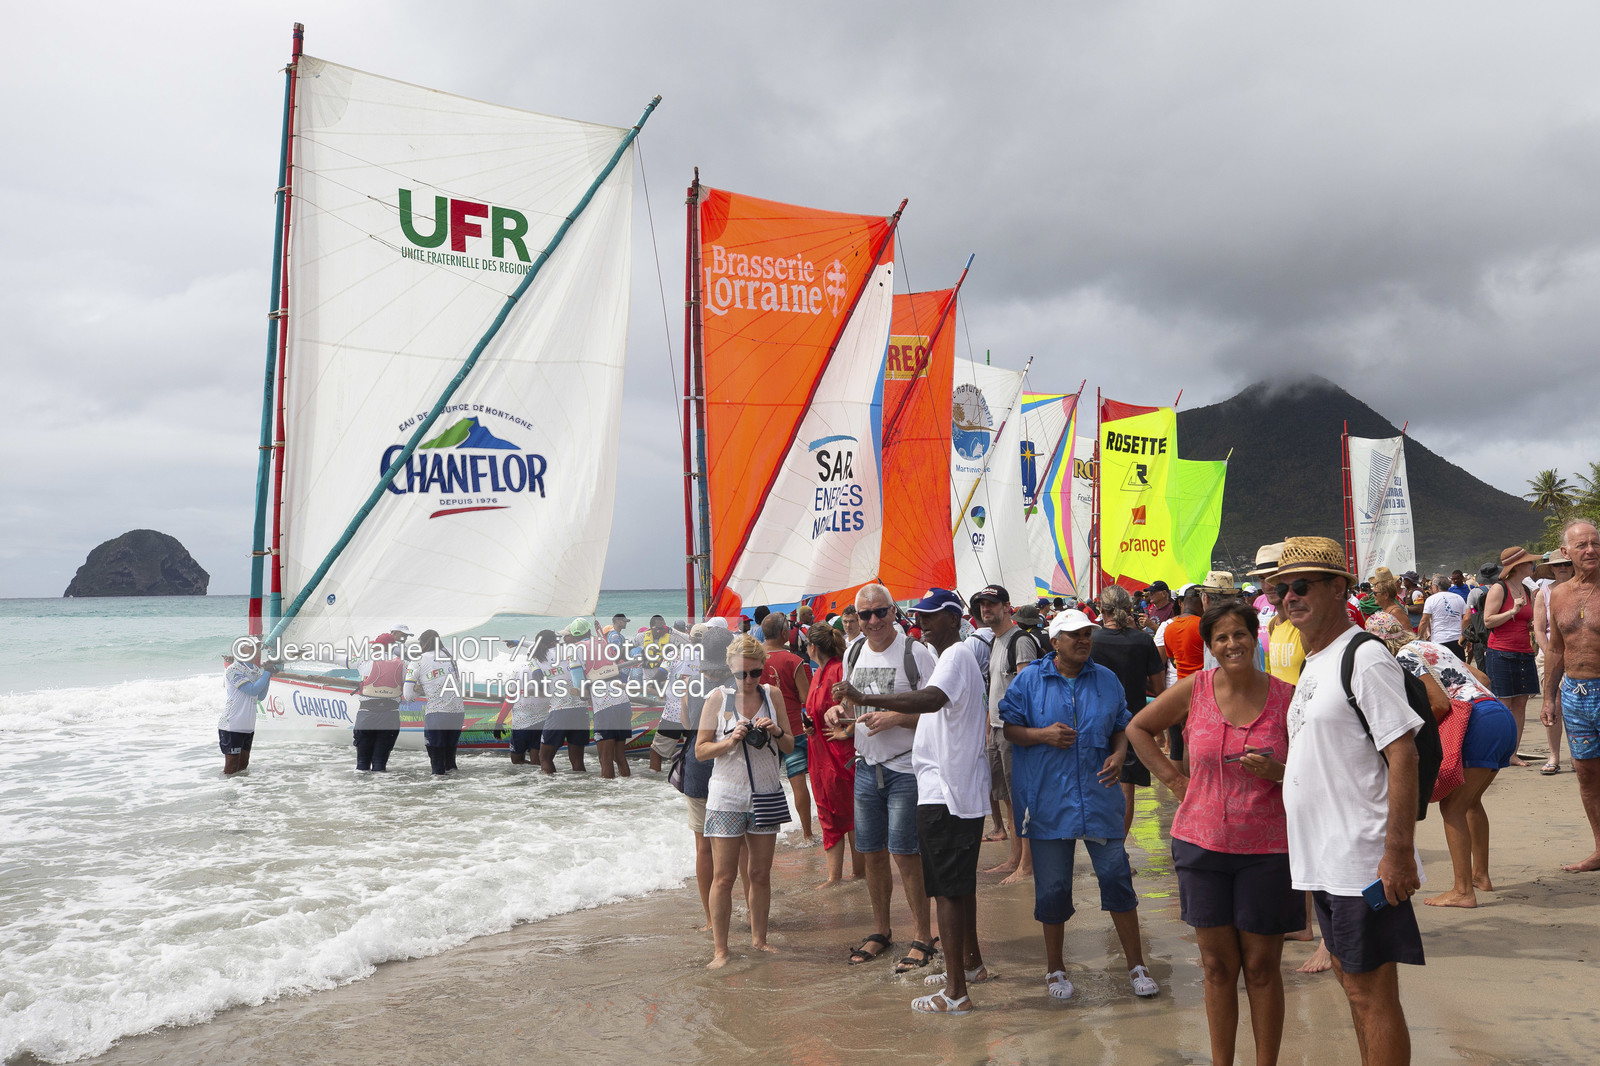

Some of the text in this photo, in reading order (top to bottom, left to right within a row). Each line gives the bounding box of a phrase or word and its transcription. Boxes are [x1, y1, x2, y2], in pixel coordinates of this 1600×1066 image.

[398, 188, 532, 263] UFR
[401, 246, 425, 262] UNITE
[427, 251, 480, 270] FRATERNELLE
[482, 259, 497, 272] DES
[711, 245, 815, 283] Brasserie
[704, 266, 823, 316] Lorraine
[398, 417, 415, 432] EAU
[473, 403, 484, 412] DE
[485, 405, 533, 431] MONTAGNE
[1106, 431, 1168, 456] ROSETTE
[380, 444, 548, 499] CHANFLOR
[439, 498, 473, 506] DEPUIS
[1119, 536, 1166, 557] orange
[426, 667, 446, 680] UFR
[543, 666, 565, 678] UFR
[292, 689, 354, 724] CHANFLOR
